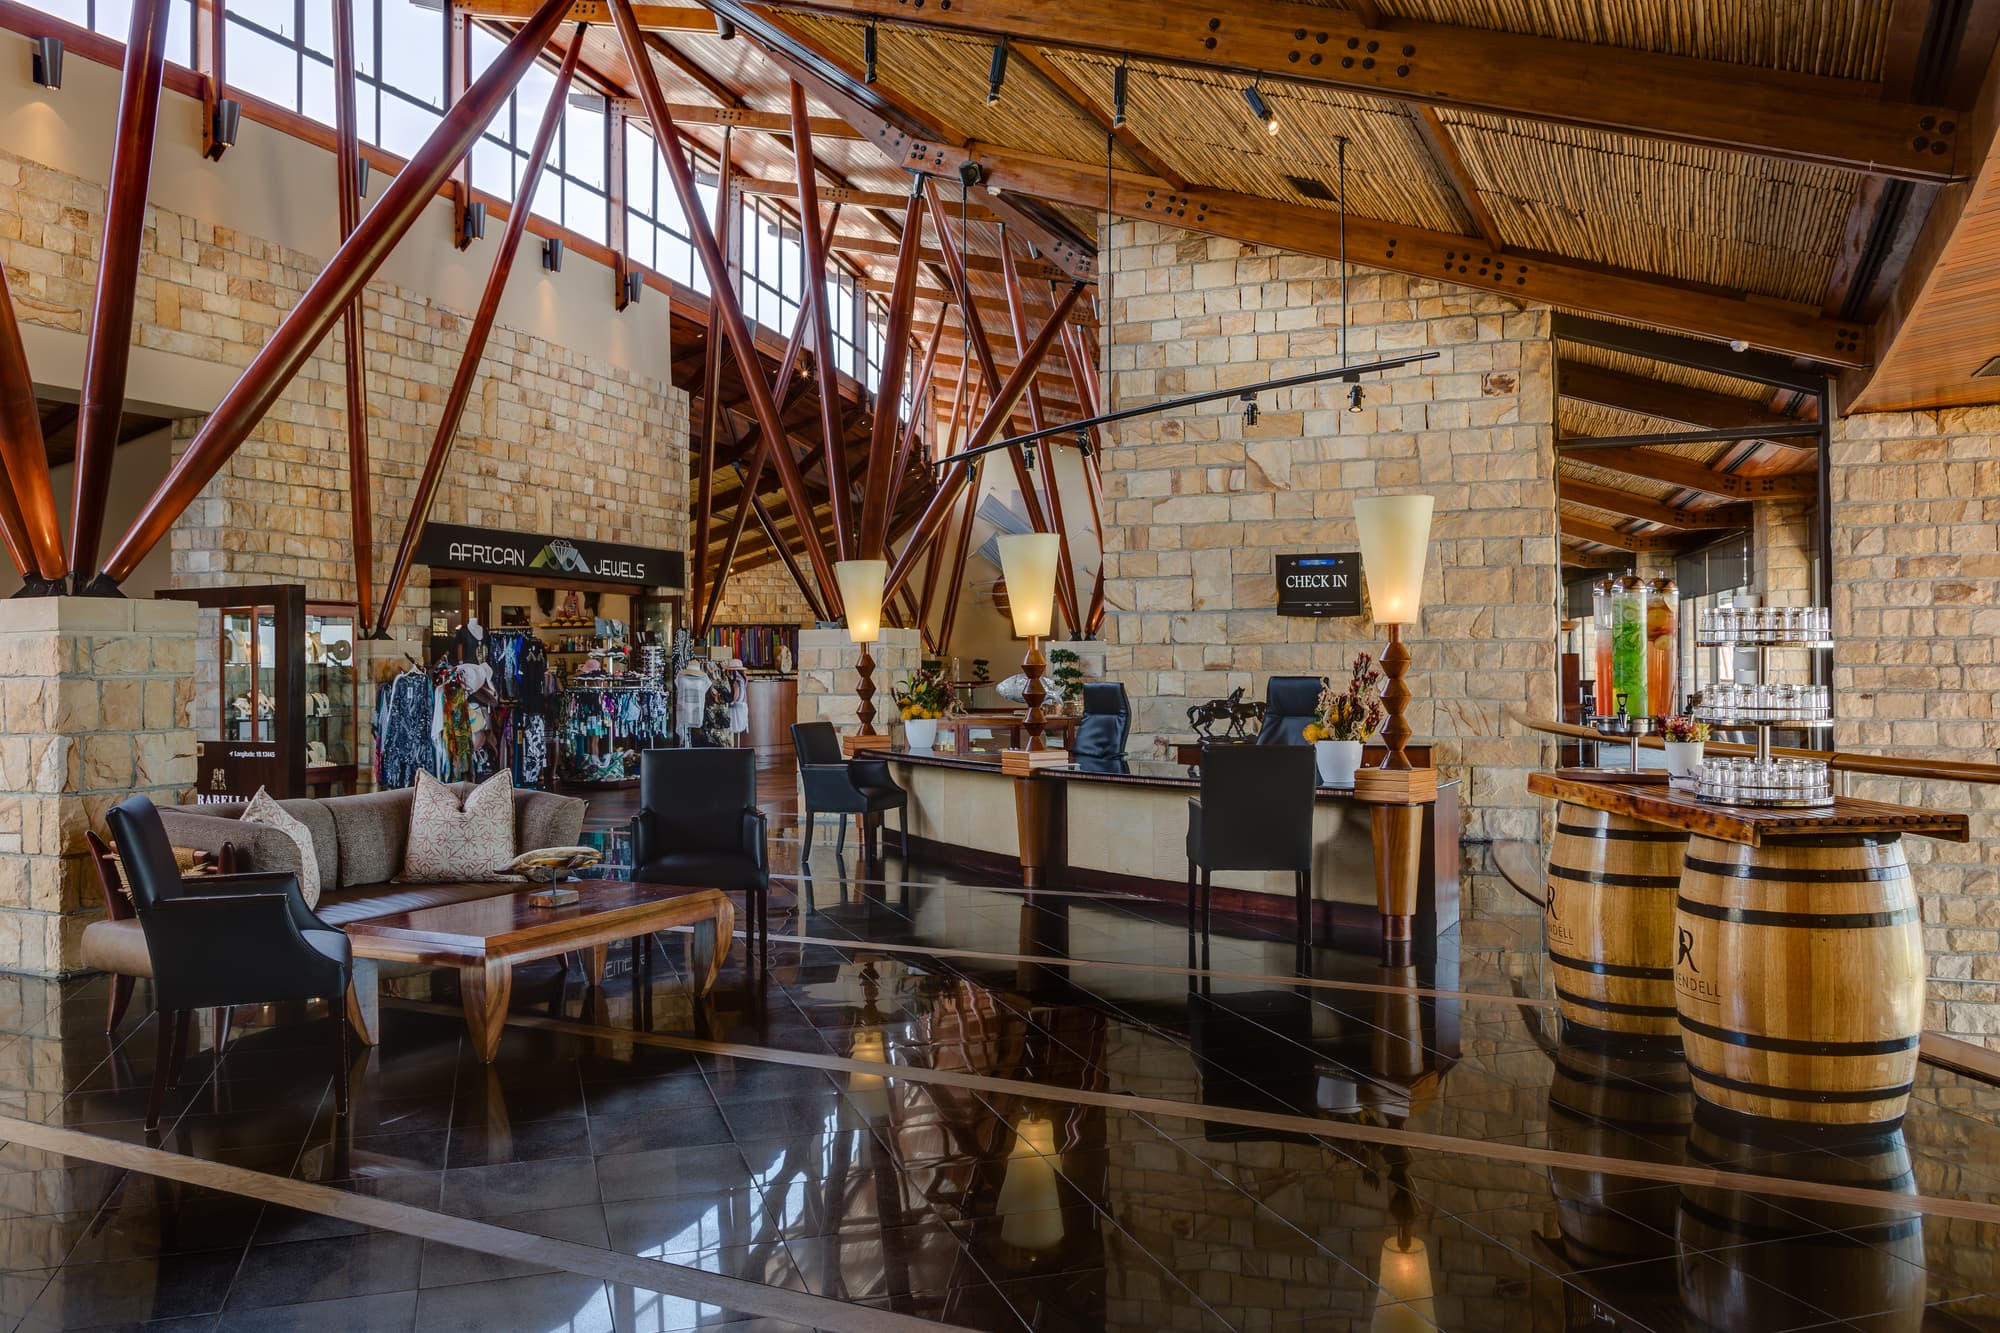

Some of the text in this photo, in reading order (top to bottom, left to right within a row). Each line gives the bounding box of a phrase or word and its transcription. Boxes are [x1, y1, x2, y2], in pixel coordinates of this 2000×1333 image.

[449, 542, 646, 579] AFRICAN JEWELS
[1286, 574, 1349, 588] CHECK IN
[1678, 925, 1700, 973] R
